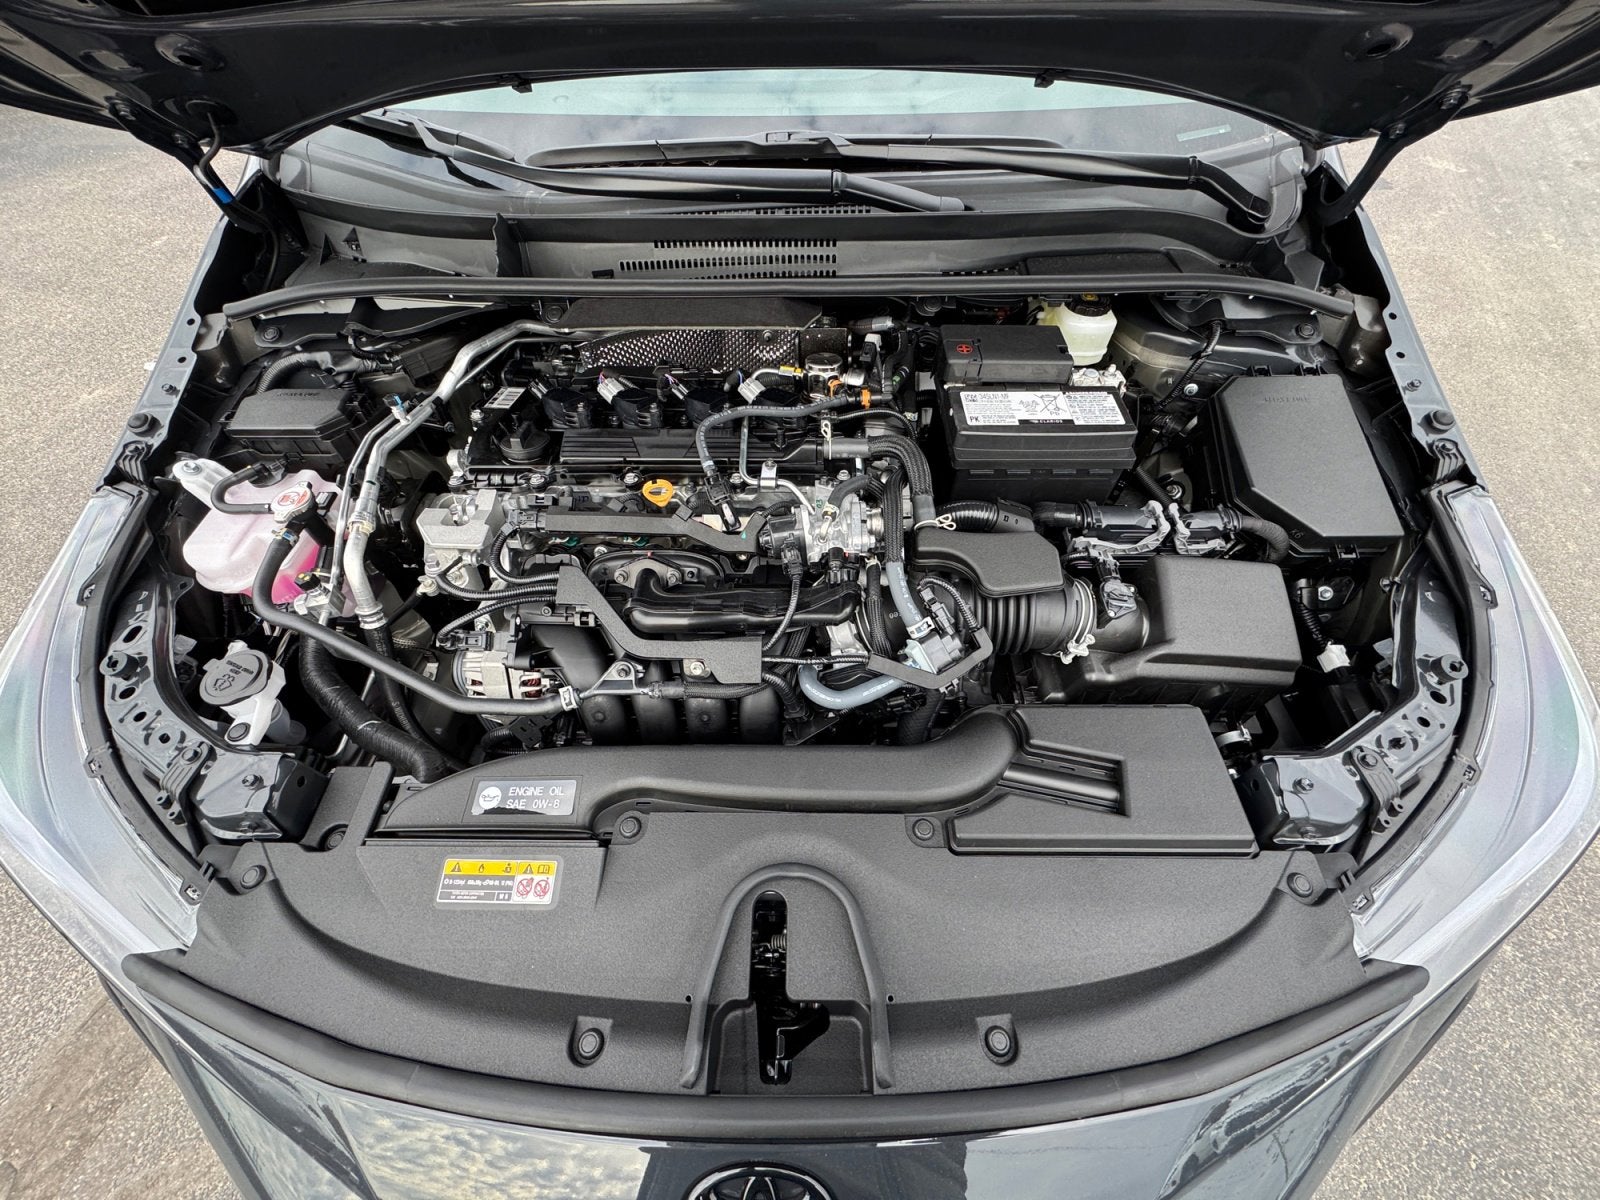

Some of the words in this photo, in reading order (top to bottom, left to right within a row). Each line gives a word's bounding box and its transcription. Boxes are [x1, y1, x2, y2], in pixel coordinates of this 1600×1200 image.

[508, 786, 544, 796] ENGINE
[549, 786, 565, 796] OIL
[505, 799, 526, 809] SAE
[532, 799, 560, 809] 0W-8
